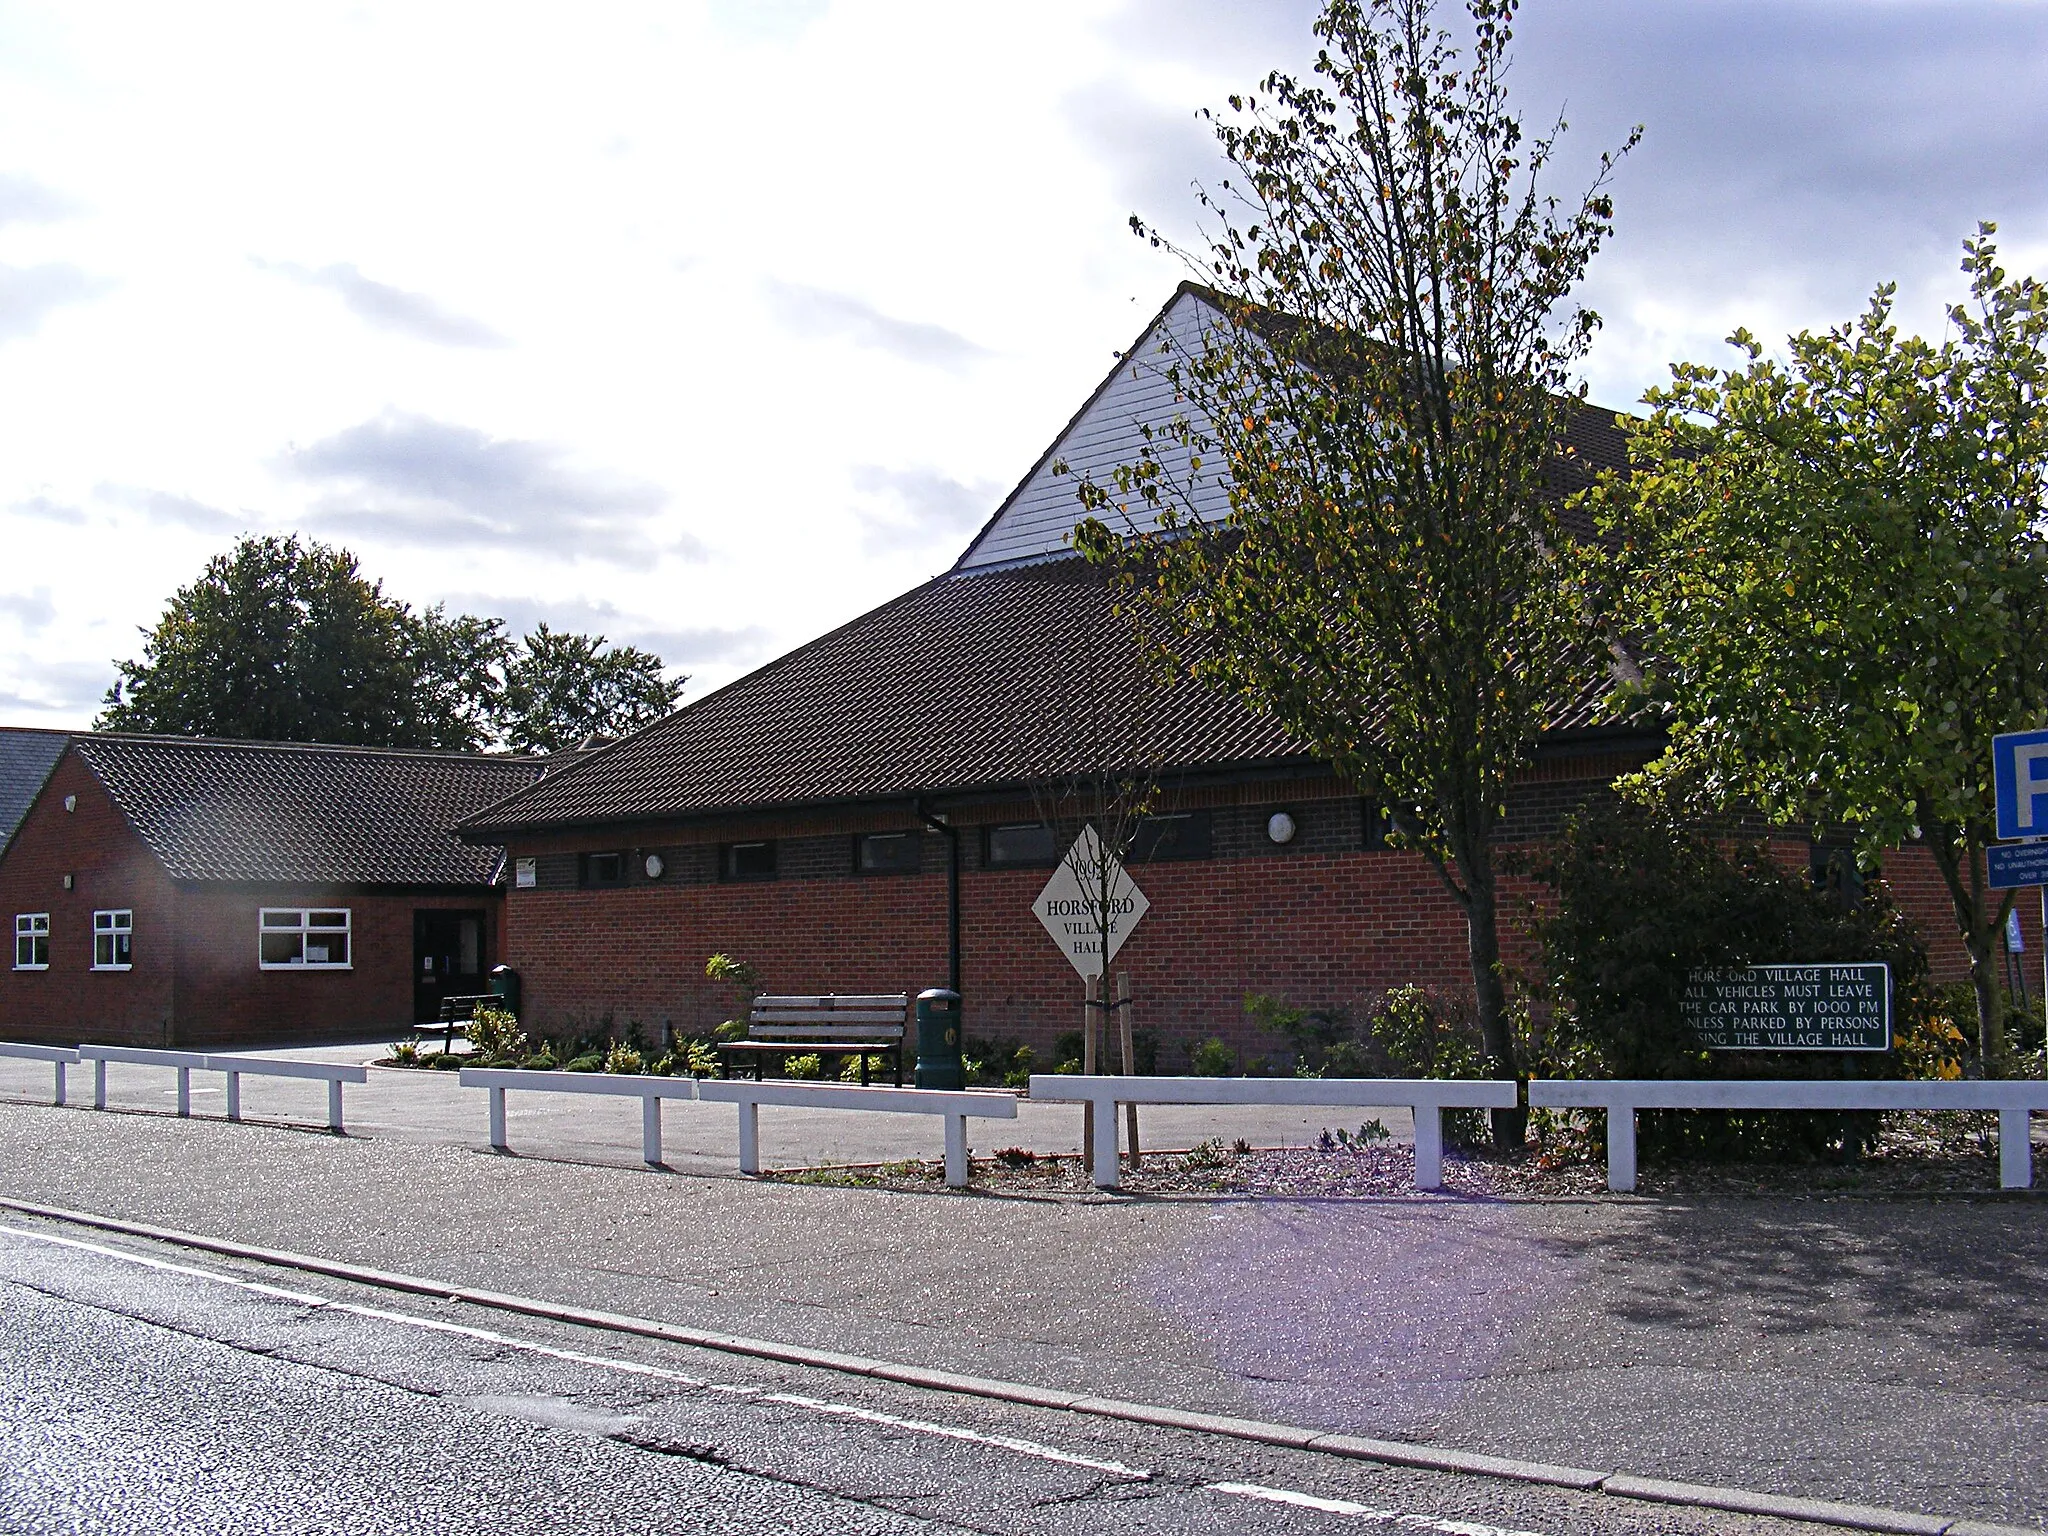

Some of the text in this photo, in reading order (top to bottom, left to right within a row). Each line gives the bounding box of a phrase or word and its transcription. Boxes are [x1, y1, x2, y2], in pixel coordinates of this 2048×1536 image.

[1063, 921, 1118, 935] VILLAE
[1689, 969, 1865, 983] HORSORD VILLAGE HALL
[1684, 984, 1872, 998] ALL VEHICLES MUST LEAVE
[1678, 1001, 1702, 1014] THE
[1709, 1001, 1737, 1014] CAR
[1743, 1001, 1779, 1014] PARK
[1789, 1001, 1806, 1013] BY
[1858, 1001, 1878, 1013] PM
[1685, 1016, 1880, 1029] NLESS PARKED BY PERSONS
[1696, 1033, 1867, 1045] SING THE VILLAGE HALL
